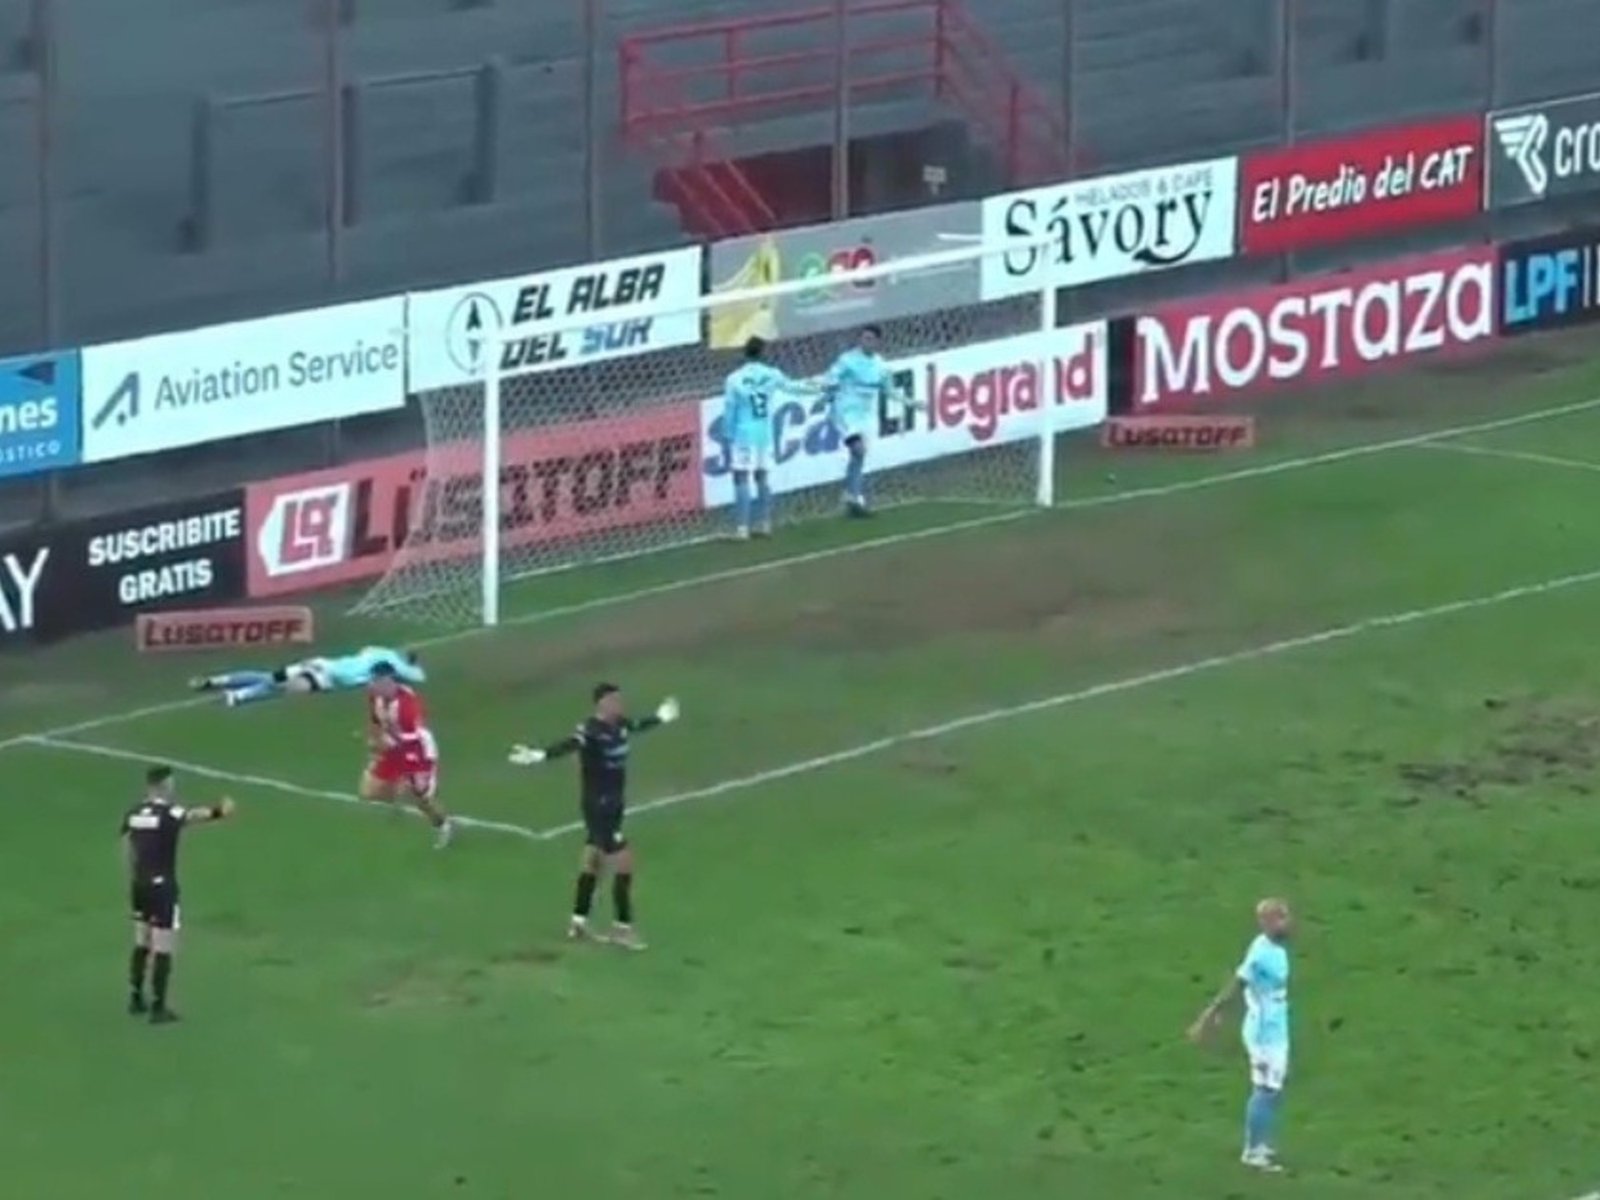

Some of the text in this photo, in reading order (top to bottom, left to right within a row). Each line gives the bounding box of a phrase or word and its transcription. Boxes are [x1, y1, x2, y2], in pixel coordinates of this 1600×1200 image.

[1252, 145, 1475, 222] El Predio del CAT
[511, 262, 666, 325] EL ALBA
[1505, 249, 1579, 325] LPF
[153, 339, 399, 412] Aviation Service
[499, 332, 568, 371] DEL
[0, 438, 61, 464] STICO
[87, 507, 242, 567] SUSCRIBITE
[118, 558, 214, 603] GRATIS
